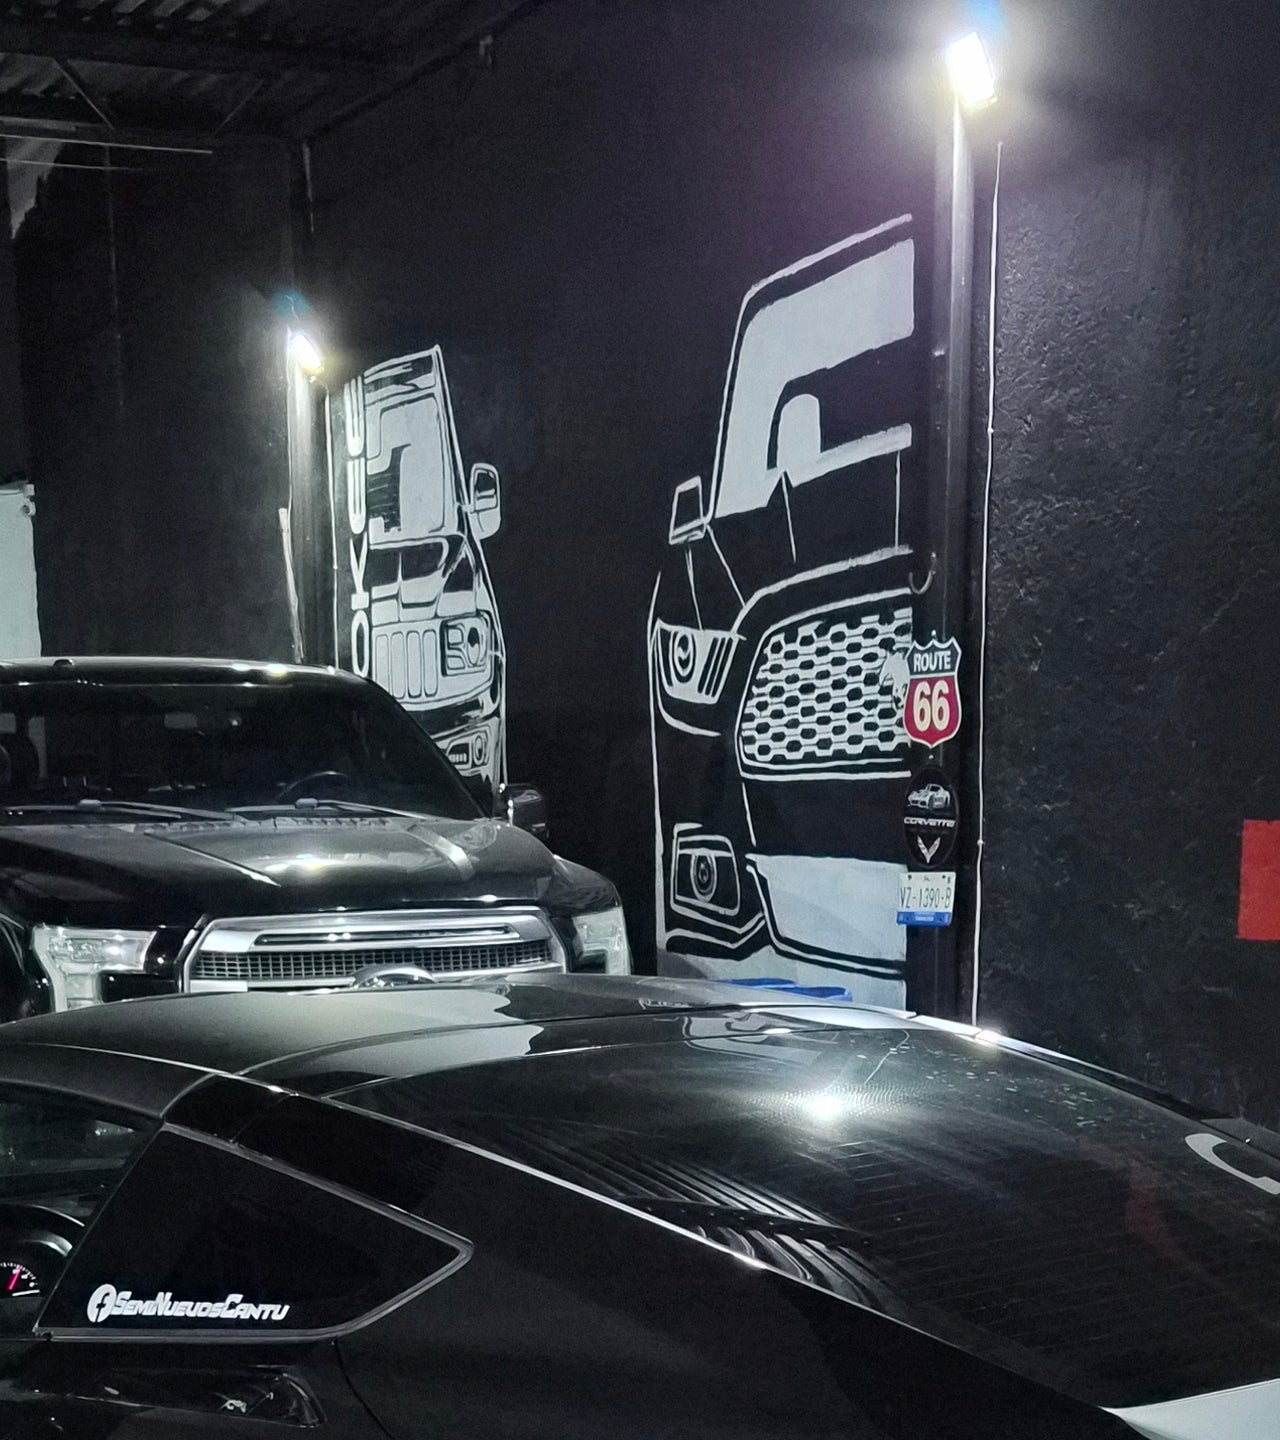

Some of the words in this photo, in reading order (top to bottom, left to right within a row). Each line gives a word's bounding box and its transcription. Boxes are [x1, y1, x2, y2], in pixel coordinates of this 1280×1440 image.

[344, 373, 370, 678] OKEE
[913, 650, 952, 673] ROUTE
[912, 680, 951, 732] 66
[903, 816, 956, 828] CORVETTE
